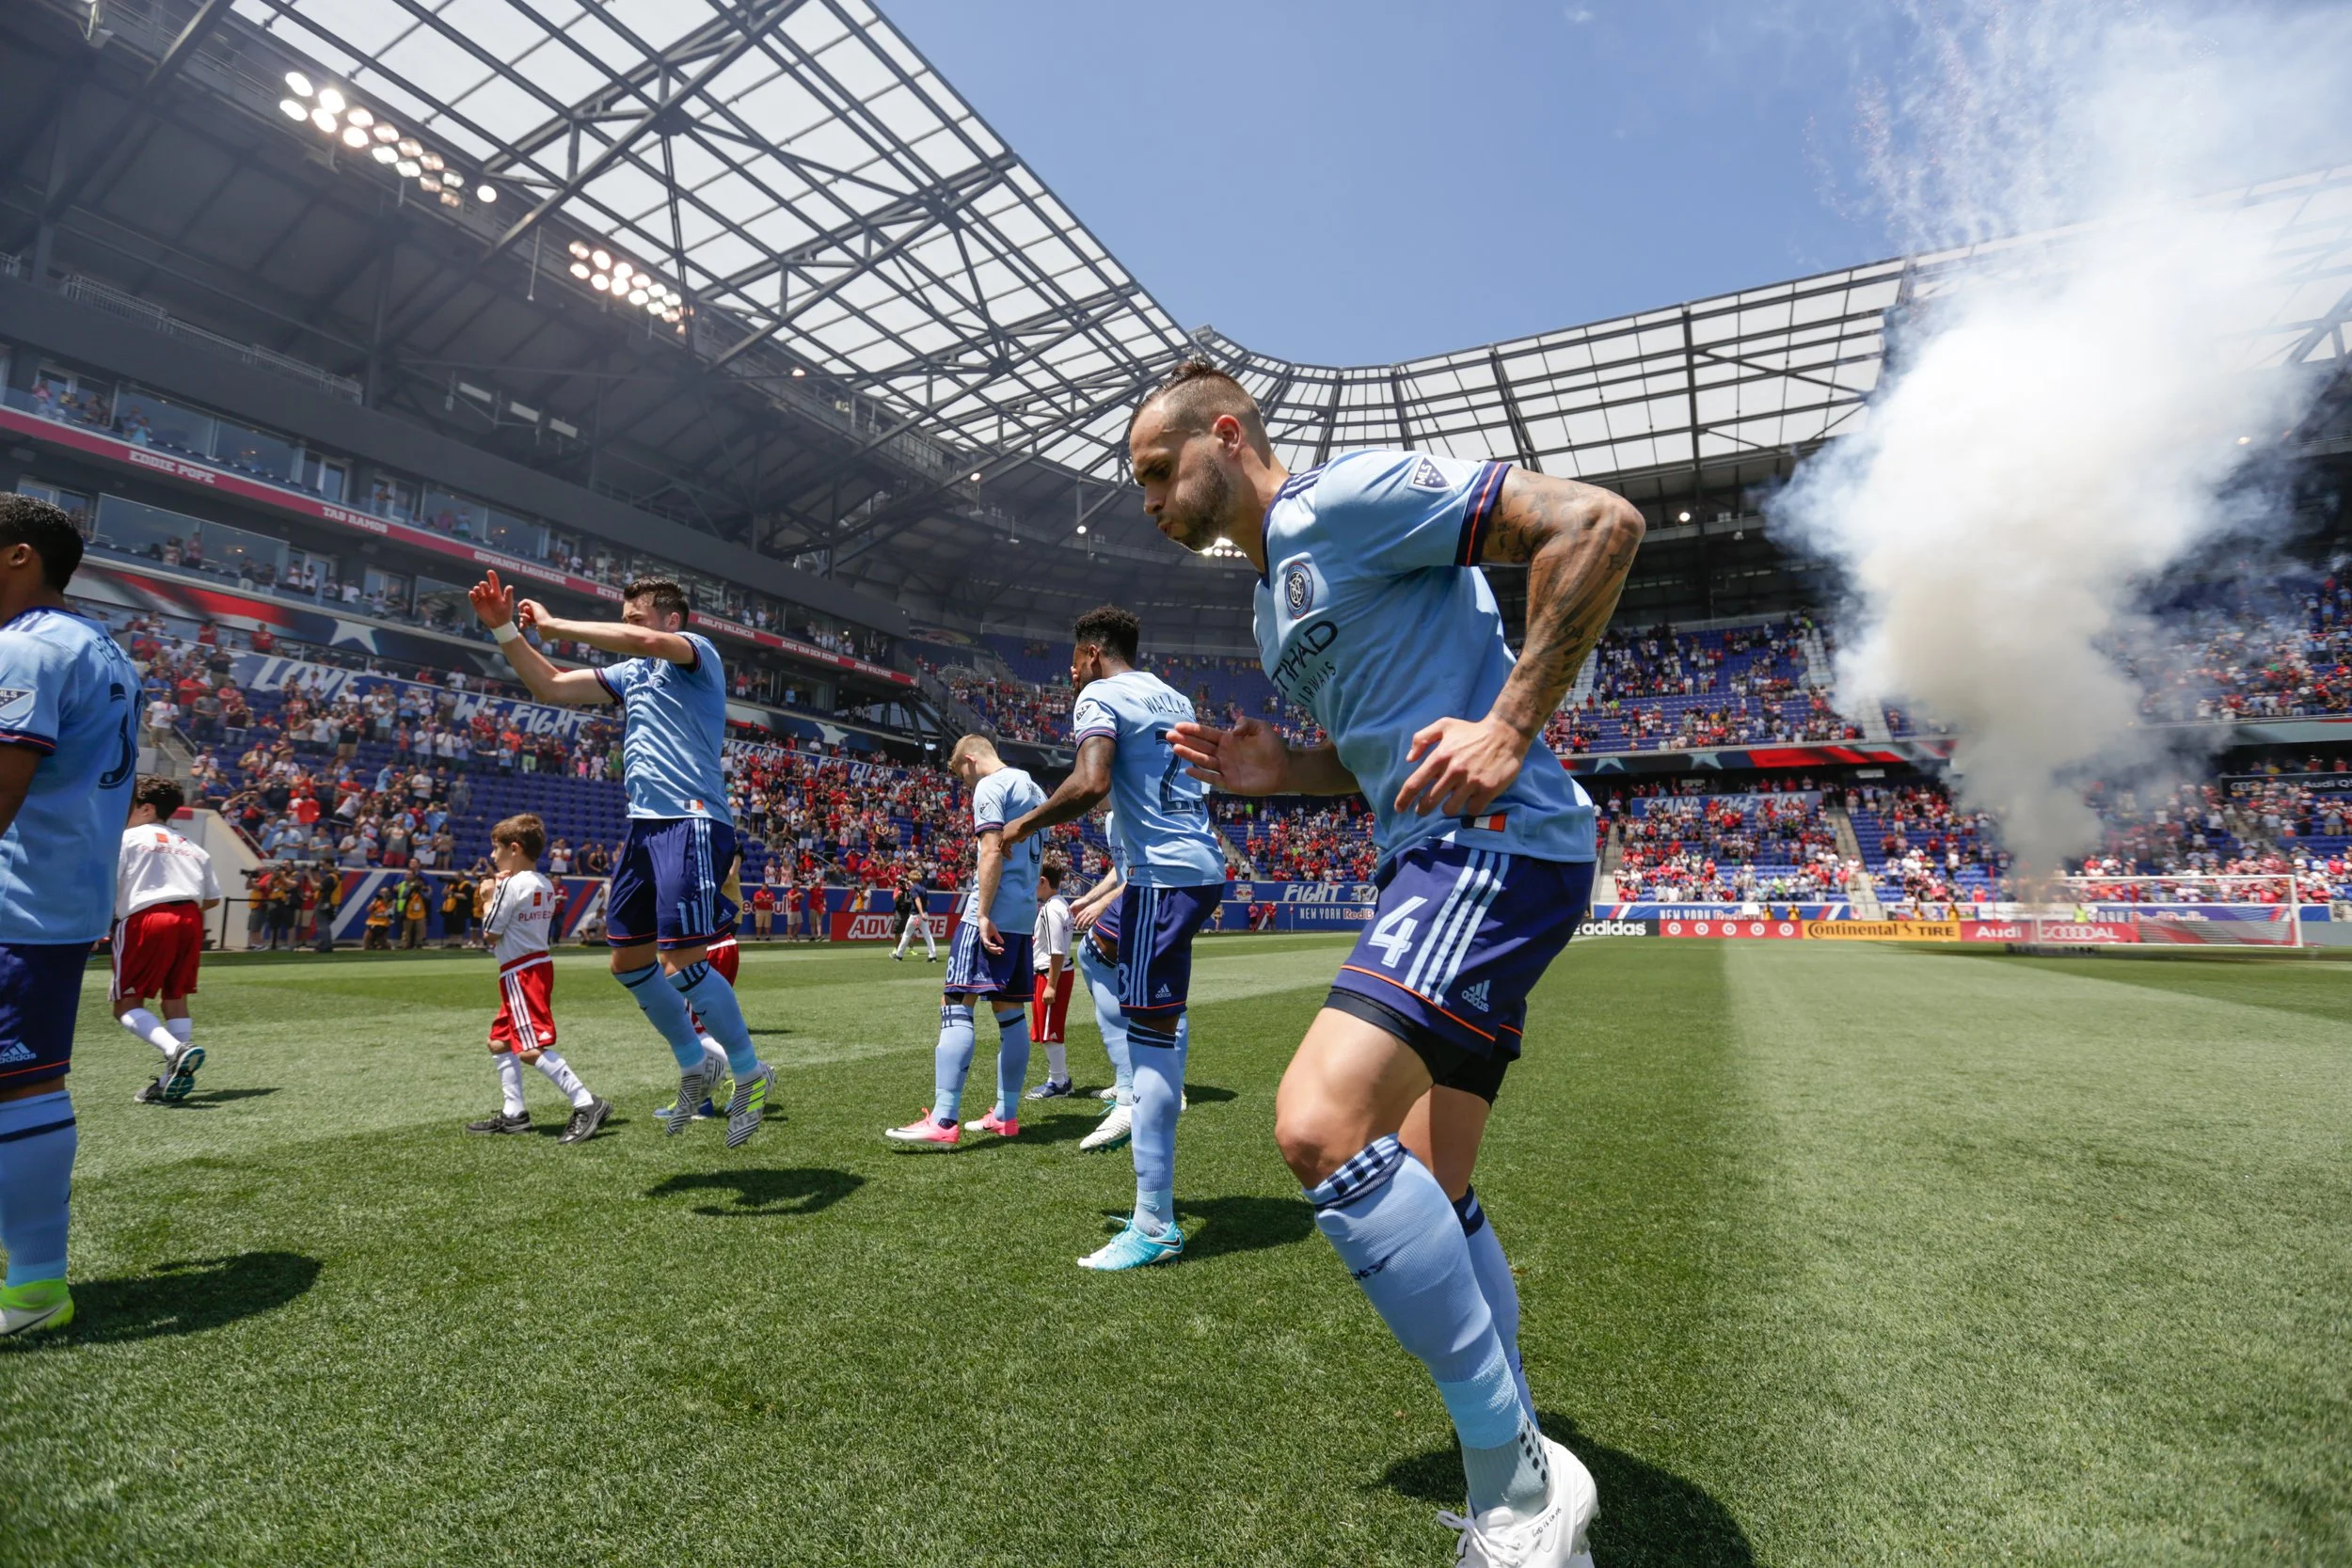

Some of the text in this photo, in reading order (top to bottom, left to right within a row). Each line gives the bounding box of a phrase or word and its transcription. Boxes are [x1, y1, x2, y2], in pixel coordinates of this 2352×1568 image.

[177, 464, 215, 483] POPE
[1414, 464, 1433, 485] MLS
[323, 506, 346, 521] TAB
[1271, 621, 1339, 696] TIHAD
[510, 704, 596, 741] FIGHT
[1282, 882, 1344, 902] FIGHT
[677, 900, 701, 935] 11
[1300, 908, 1375, 920] NEW YORK RedB
[1660, 910, 1682, 920] NEW
[1684, 910, 1711, 920] YORK
[1368, 895, 1428, 969] 4
[1581, 922, 1646, 936] adidas
[1808, 921, 1956, 939] Continental TIRE
[1976, 926, 2022, 938] Audi
[946, 956, 955, 983] 8
[1461, 989, 1490, 1013] adidas
